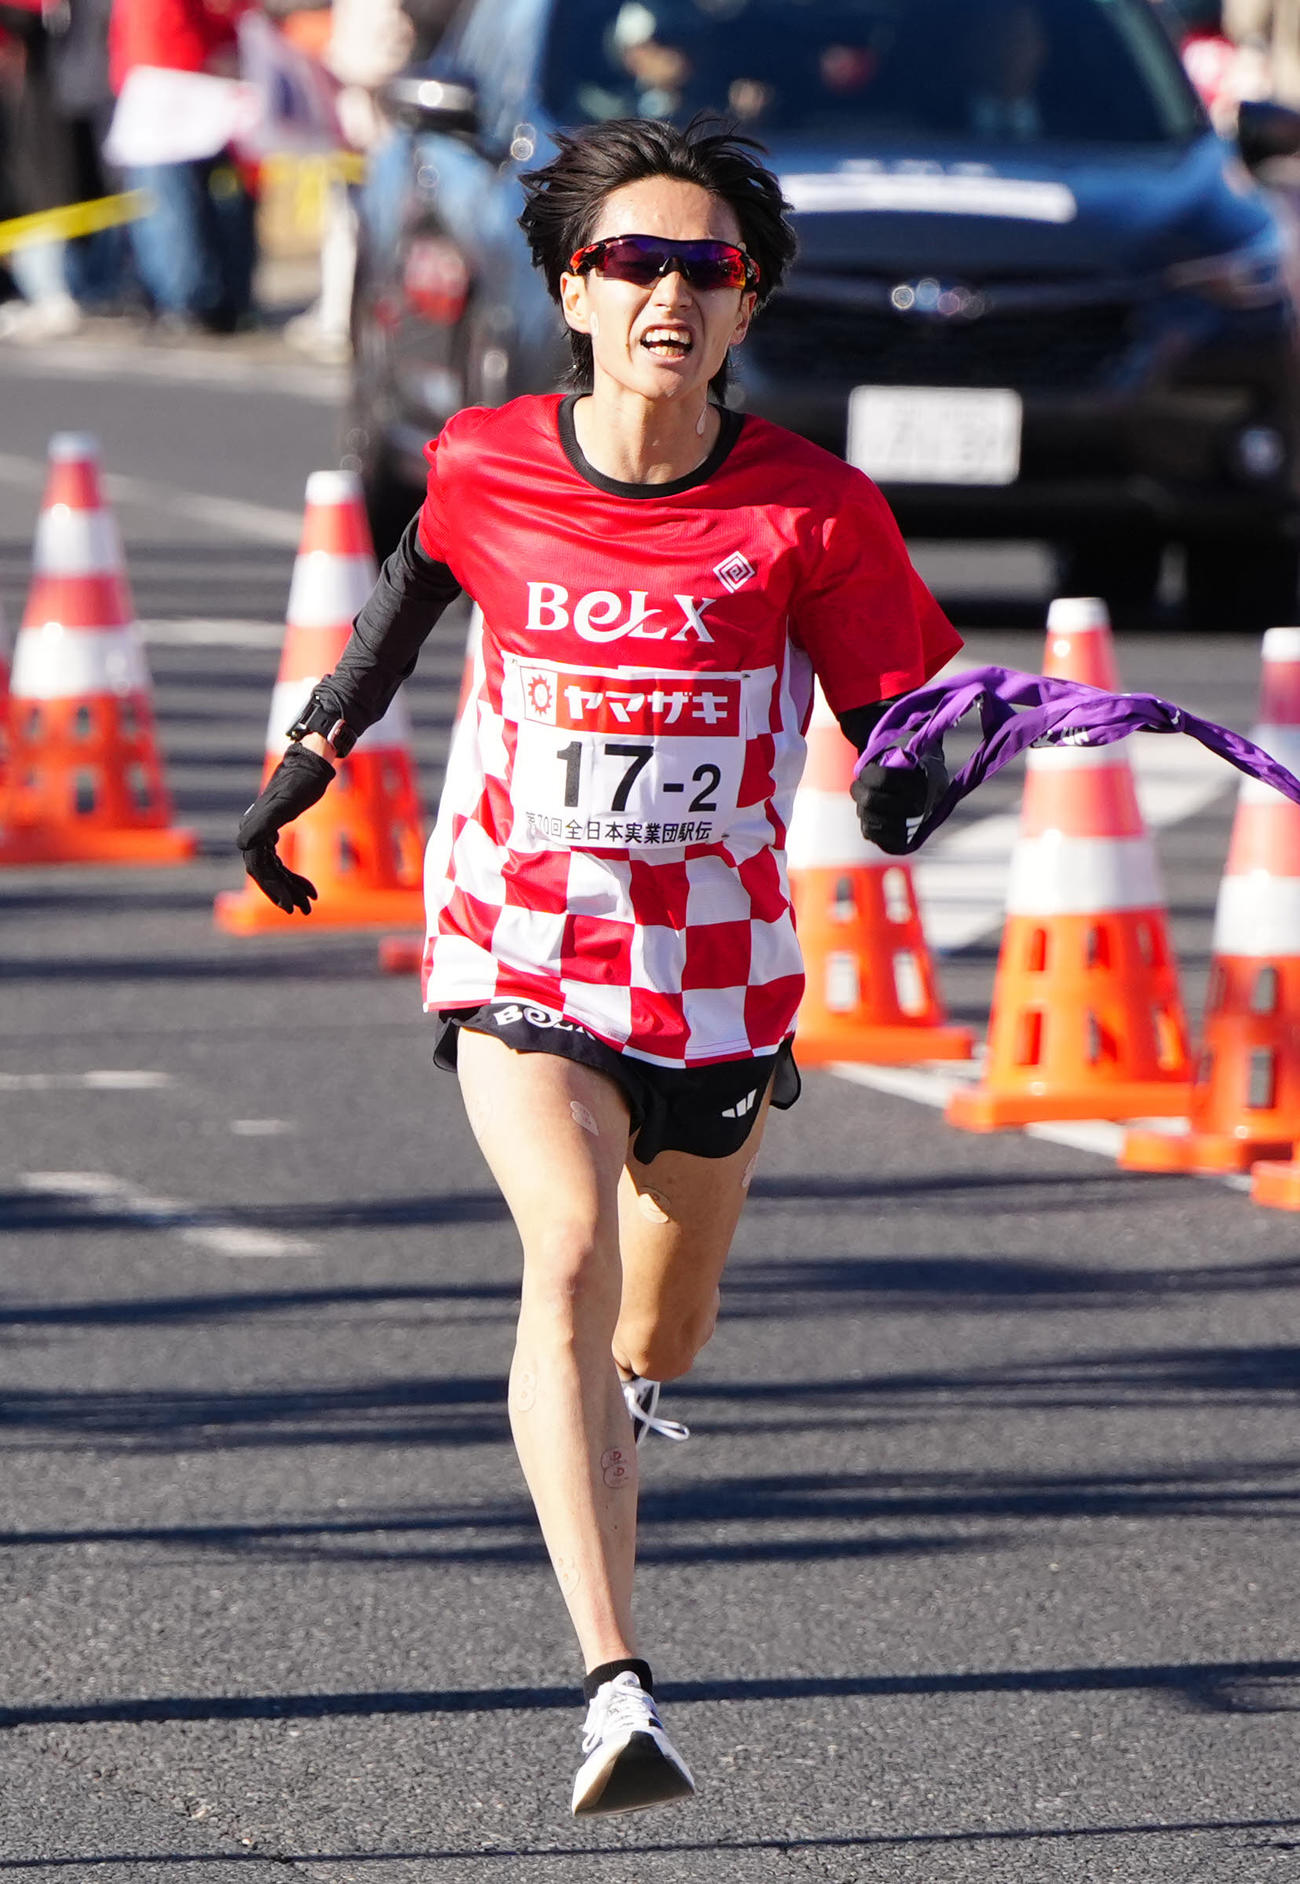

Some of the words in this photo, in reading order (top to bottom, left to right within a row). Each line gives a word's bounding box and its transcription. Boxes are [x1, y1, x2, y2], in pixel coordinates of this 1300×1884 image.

[564, 685, 728, 724] ヤマザキ
[556, 741, 721, 813] 17-2
